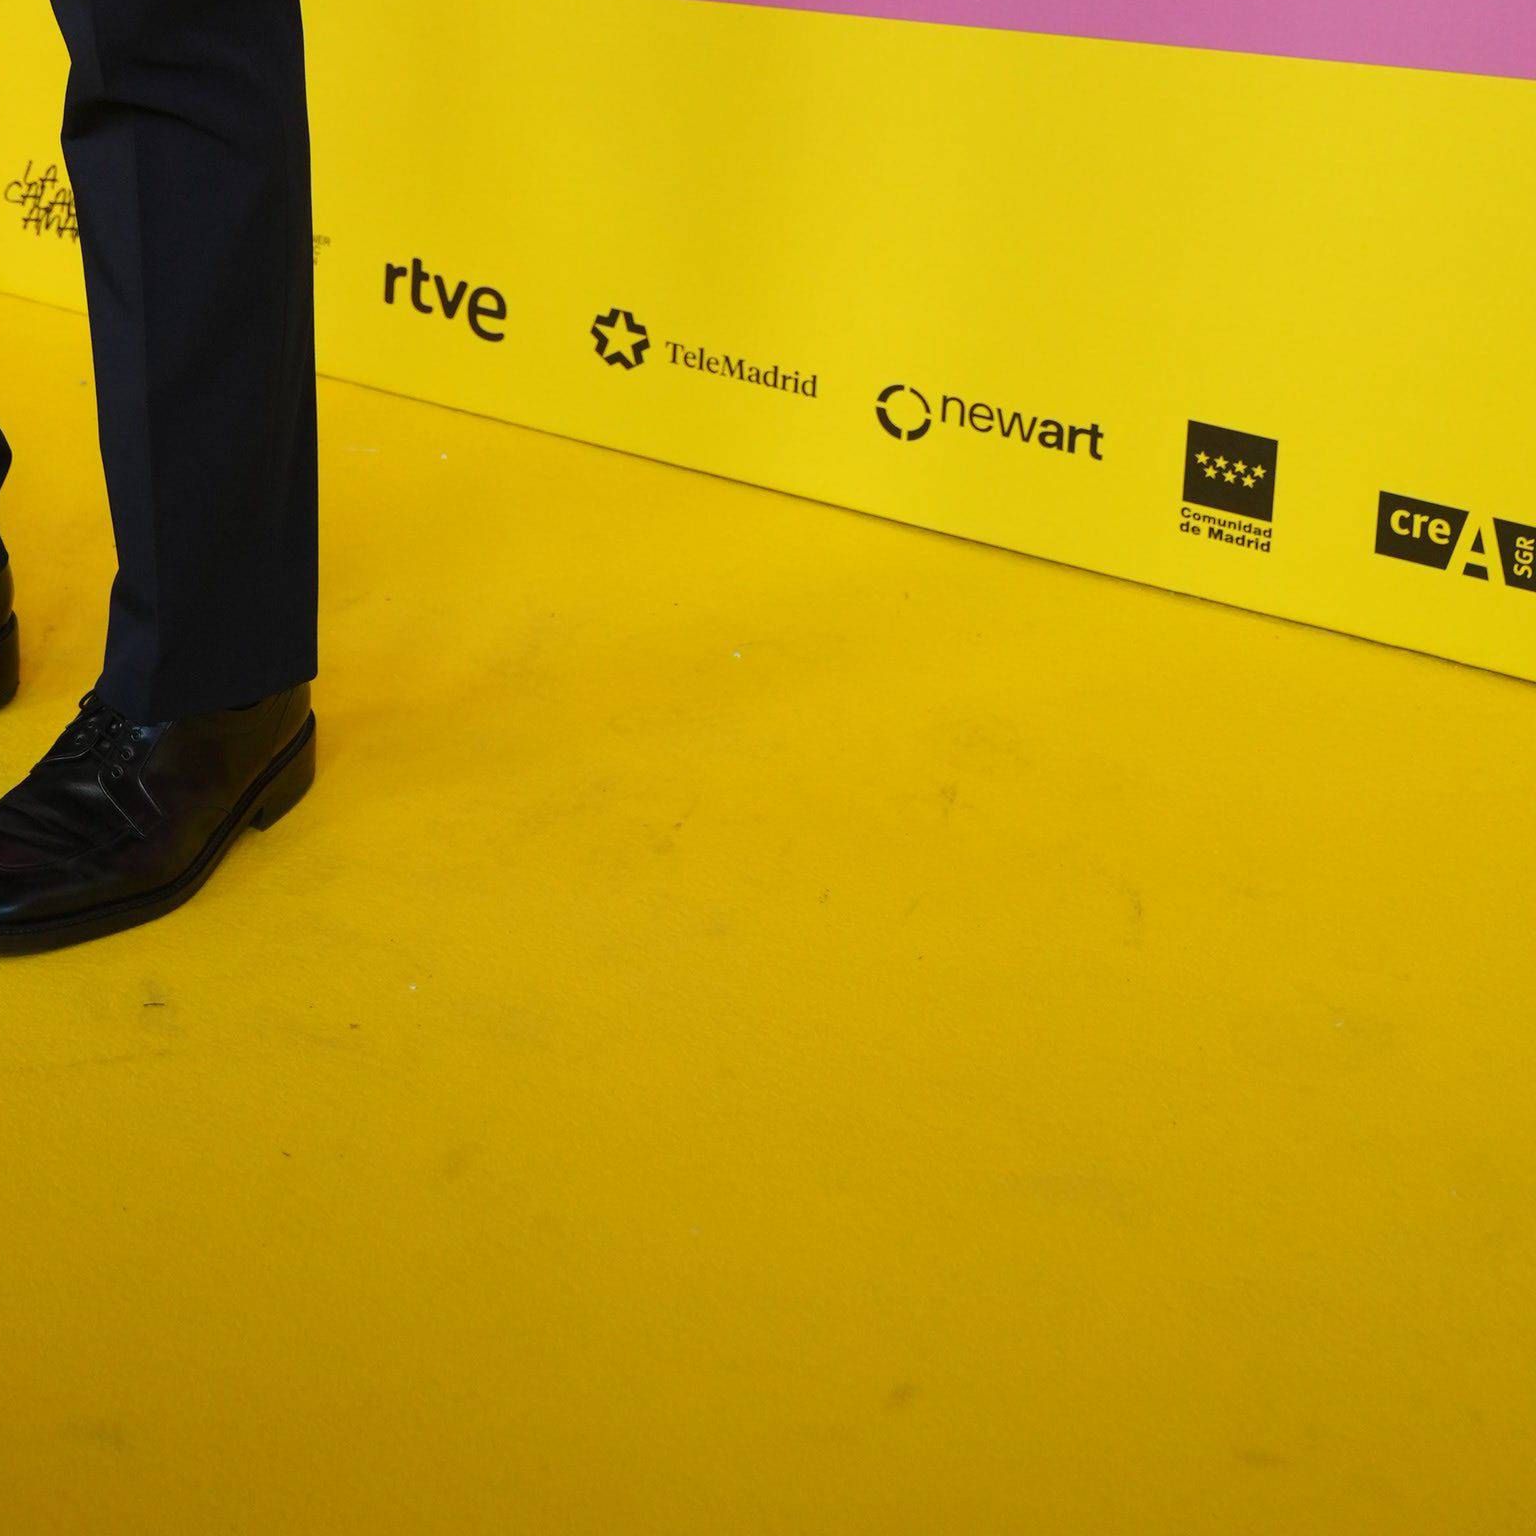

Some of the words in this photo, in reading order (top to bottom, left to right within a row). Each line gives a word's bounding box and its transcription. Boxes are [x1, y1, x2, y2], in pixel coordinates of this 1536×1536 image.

[384, 257, 507, 342] rtve
[665, 341, 818, 398] TeleMadrid
[940, 394, 1104, 460] newart
[1180, 522, 1201, 535] de
[1208, 527, 1271, 553] Madrid
[1181, 507, 1272, 538] Comunidad
[1513, 536, 1536, 579] SGR
